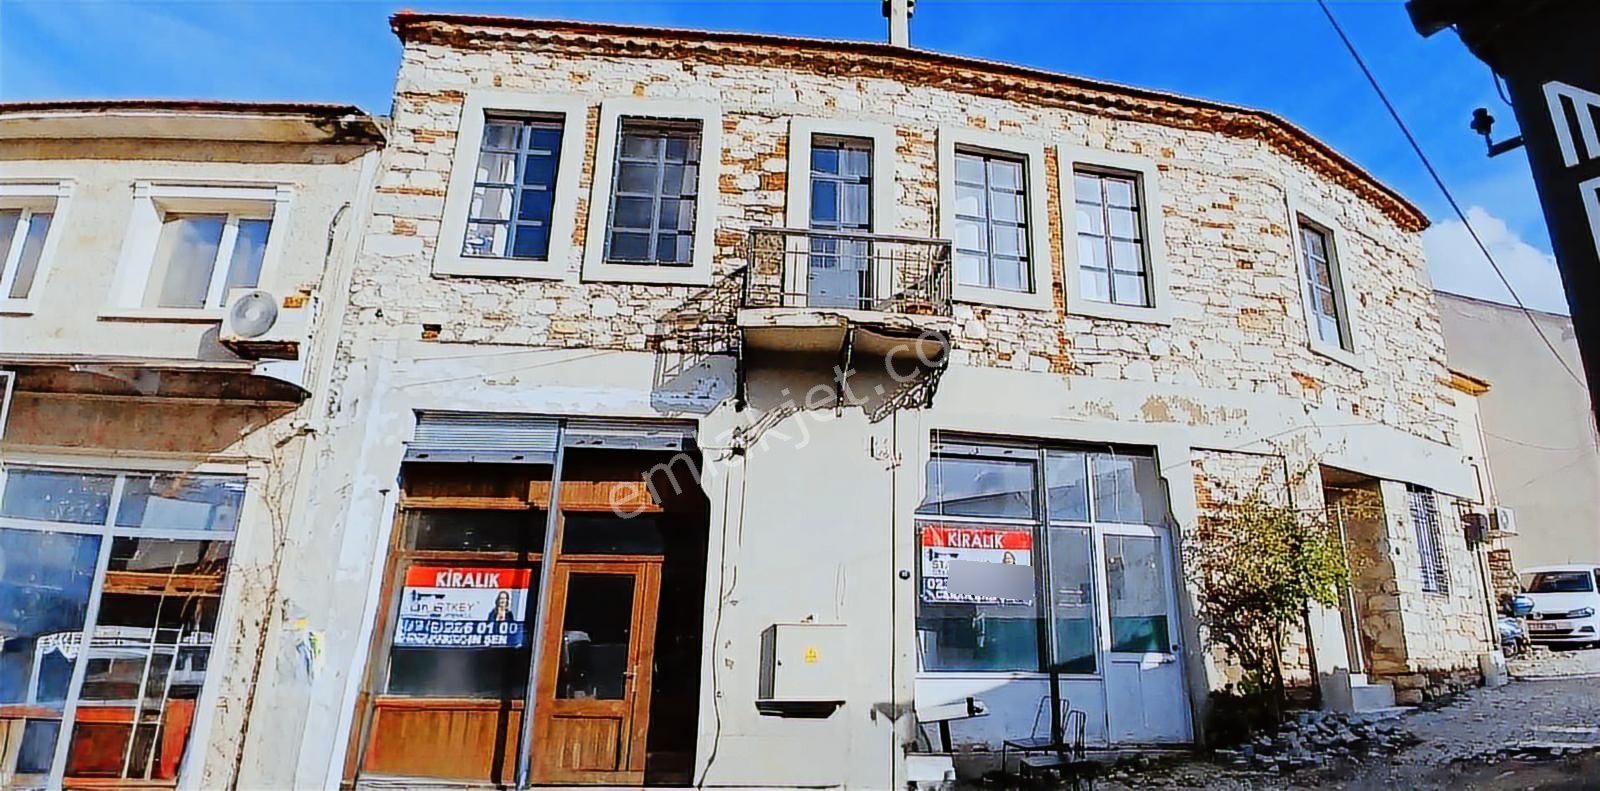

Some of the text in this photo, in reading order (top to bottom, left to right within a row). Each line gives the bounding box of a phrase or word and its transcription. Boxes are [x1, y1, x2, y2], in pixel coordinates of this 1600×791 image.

[948, 530, 1004, 549] KİRALIK
[435, 568, 501, 588] KİRALIK
[477, 622, 494, 635] 01
[499, 620, 518, 635] 00
